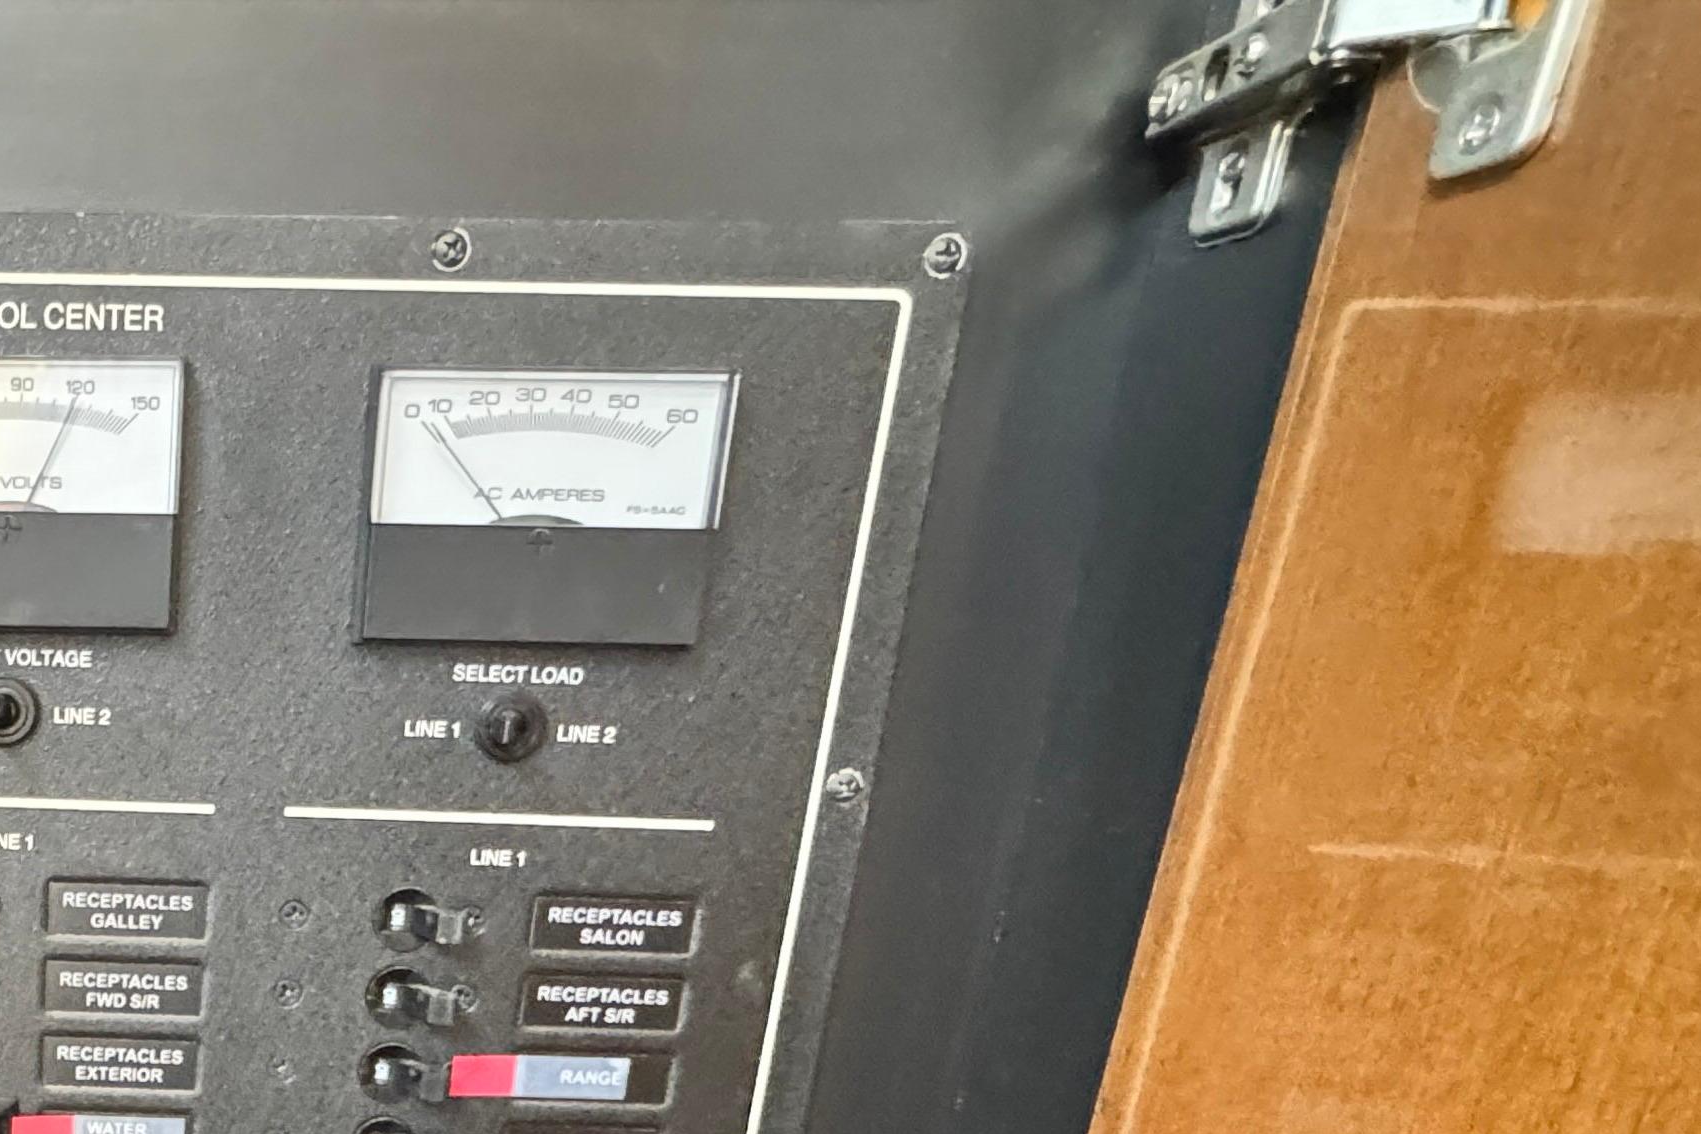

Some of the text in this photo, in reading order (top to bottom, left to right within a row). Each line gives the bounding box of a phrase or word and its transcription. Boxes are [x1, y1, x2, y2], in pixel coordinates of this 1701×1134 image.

[44, 302, 164, 332] CENTER
[10, 377, 34, 392] 90
[66, 380, 96, 396] 120
[131, 396, 160, 411] 150
[404, 388, 698, 424] 0 10 20 30 40 50 60
[0, 476, 63, 490] VOLTS
[474, 488, 606, 503] AC AMPERES
[4, 648, 93, 668] VOLTAGE
[452, 663, 585, 686] SELECT LOAD
[53, 706, 112, 726] LINE 2
[404, 719, 462, 739] LINE 1
[556, 724, 617, 744] LINE 2
[24, 834, 35, 851] 1
[470, 849, 527, 868] LINE 1
[62, 891, 194, 911] RECEPTACLES
[90, 913, 163, 930] GALLEY
[548, 906, 684, 927] RECEPTACLES
[579, 928, 645, 946] SALON
[59, 971, 188, 991] RECEPTACLES
[85, 992, 160, 1009] FWD S/R
[536, 985, 670, 1006] RECEPTACLES
[565, 1007, 636, 1025] AFT S/R
[56, 1045, 184, 1065] RECEPTACLES
[75, 1065, 164, 1083] EXTERIOR
[559, 1069, 622, 1086] RANGE
